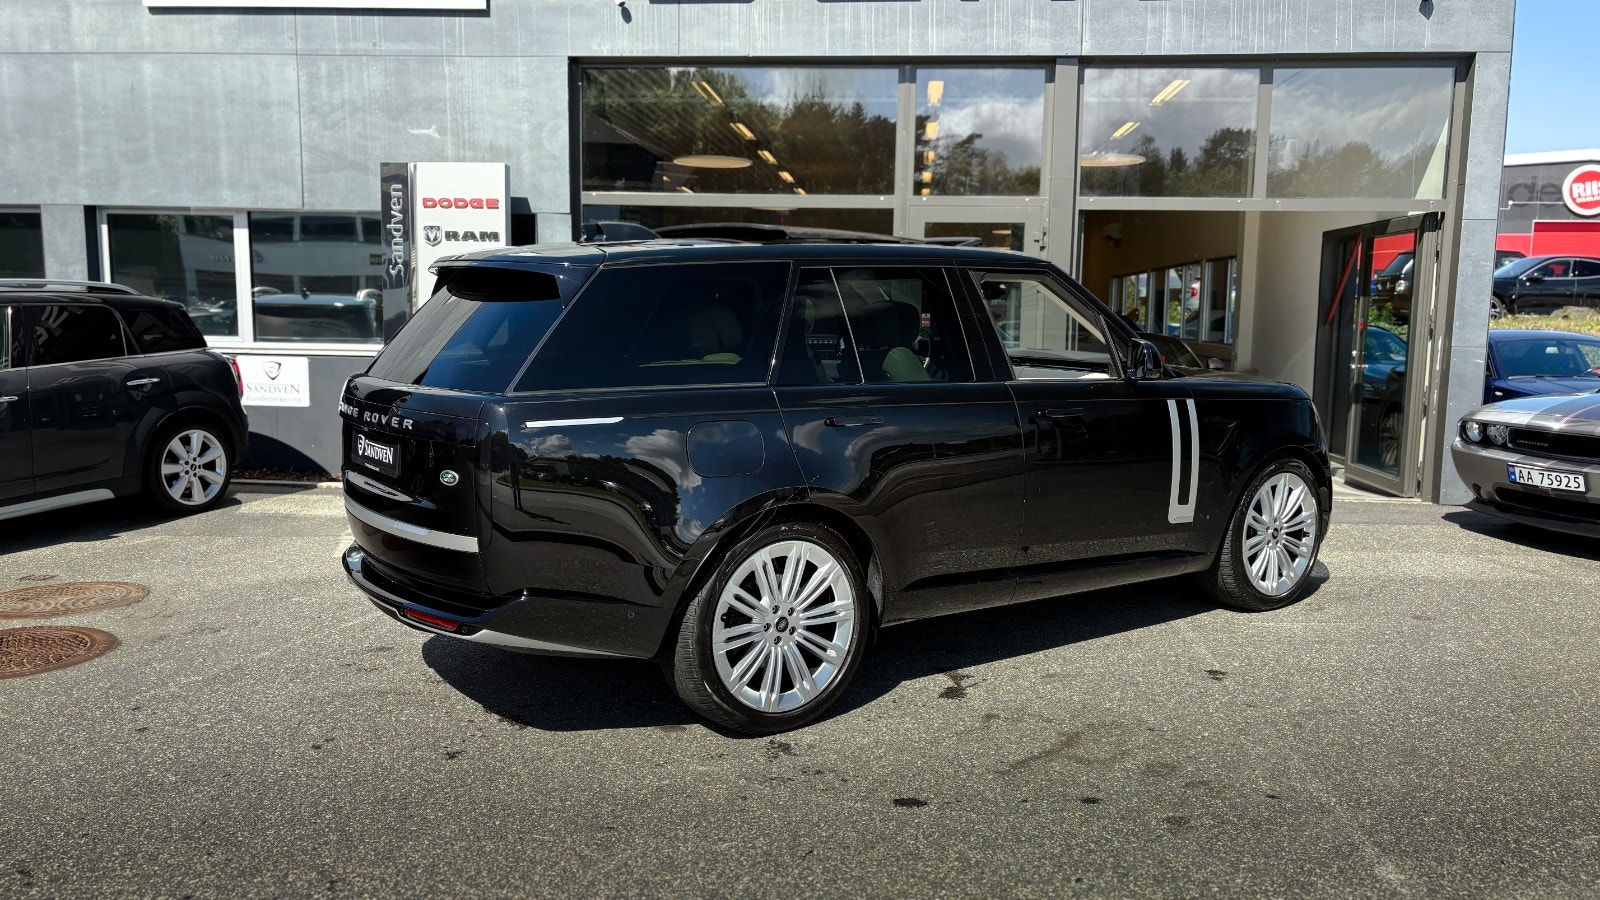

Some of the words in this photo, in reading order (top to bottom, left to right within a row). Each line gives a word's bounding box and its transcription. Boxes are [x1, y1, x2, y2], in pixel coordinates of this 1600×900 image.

[422, 197, 500, 209] DODGE
[386, 184, 404, 280] Sandven
[444, 230, 500, 242] RAM
[246, 382, 300, 394] SANDVEN
[363, 410, 413, 429] ROVER
[364, 439, 394, 465] SANDVEN
[1518, 469, 1534, 484] AA
[1538, 473, 1580, 489] 75925
